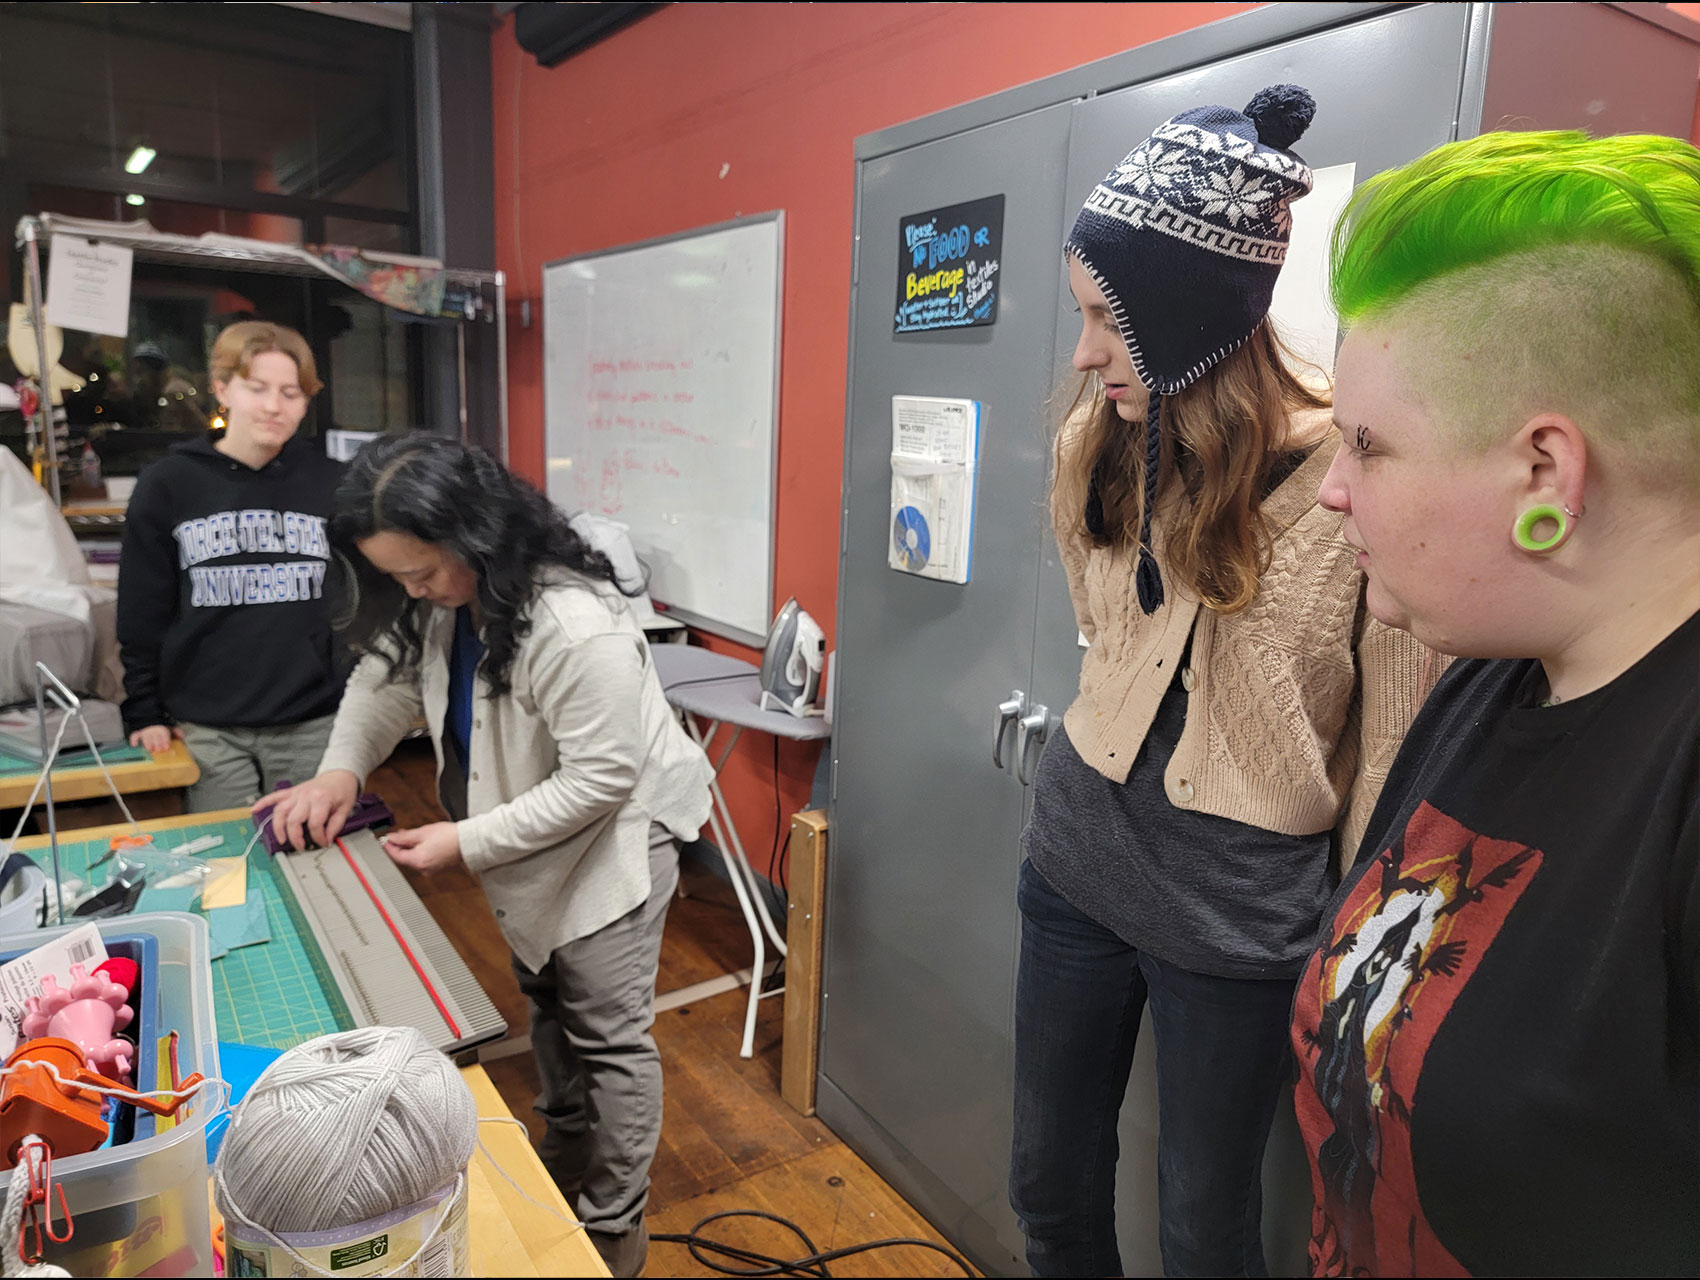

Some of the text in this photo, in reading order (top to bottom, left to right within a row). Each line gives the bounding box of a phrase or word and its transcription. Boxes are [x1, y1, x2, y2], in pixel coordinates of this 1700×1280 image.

[929, 225, 970, 269] FOOD
[906, 268, 964, 300] Beverage
[172, 509, 284, 570] ORCETER
[188, 561, 326, 607] UNIVERSITY
